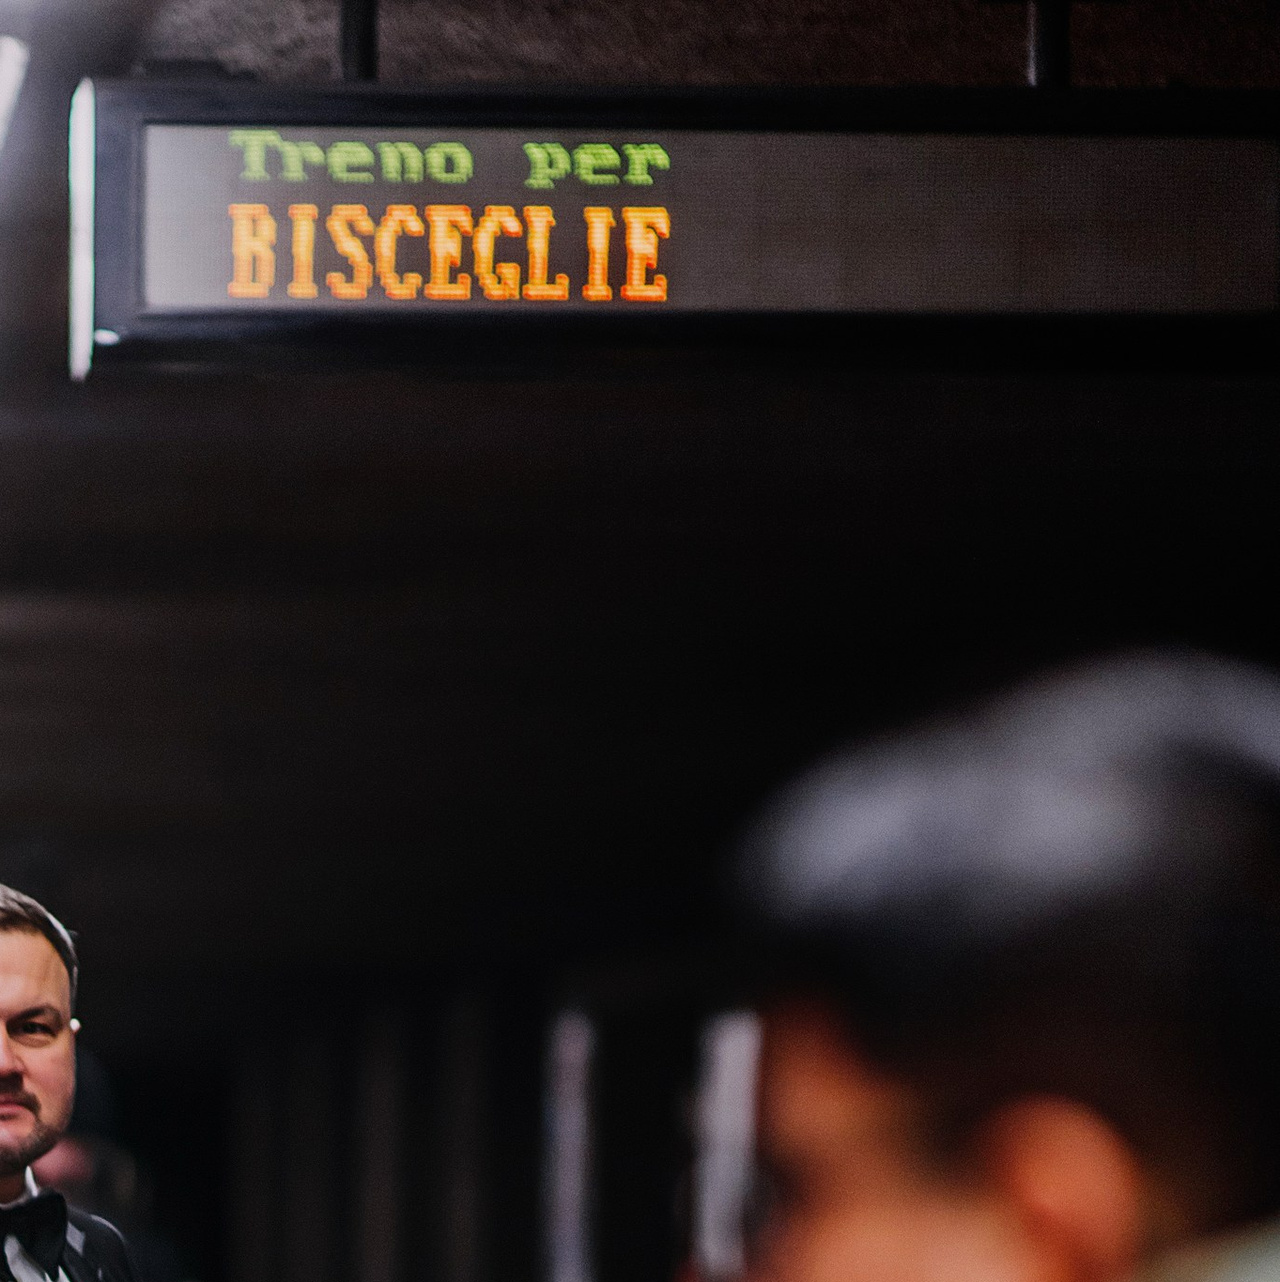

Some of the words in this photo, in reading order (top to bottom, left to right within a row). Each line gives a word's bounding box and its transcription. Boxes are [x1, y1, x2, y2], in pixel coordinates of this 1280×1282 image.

[227, 129, 474, 184] Treno
[523, 141, 671, 190] per
[227, 203, 671, 301] BISCEGLIE
